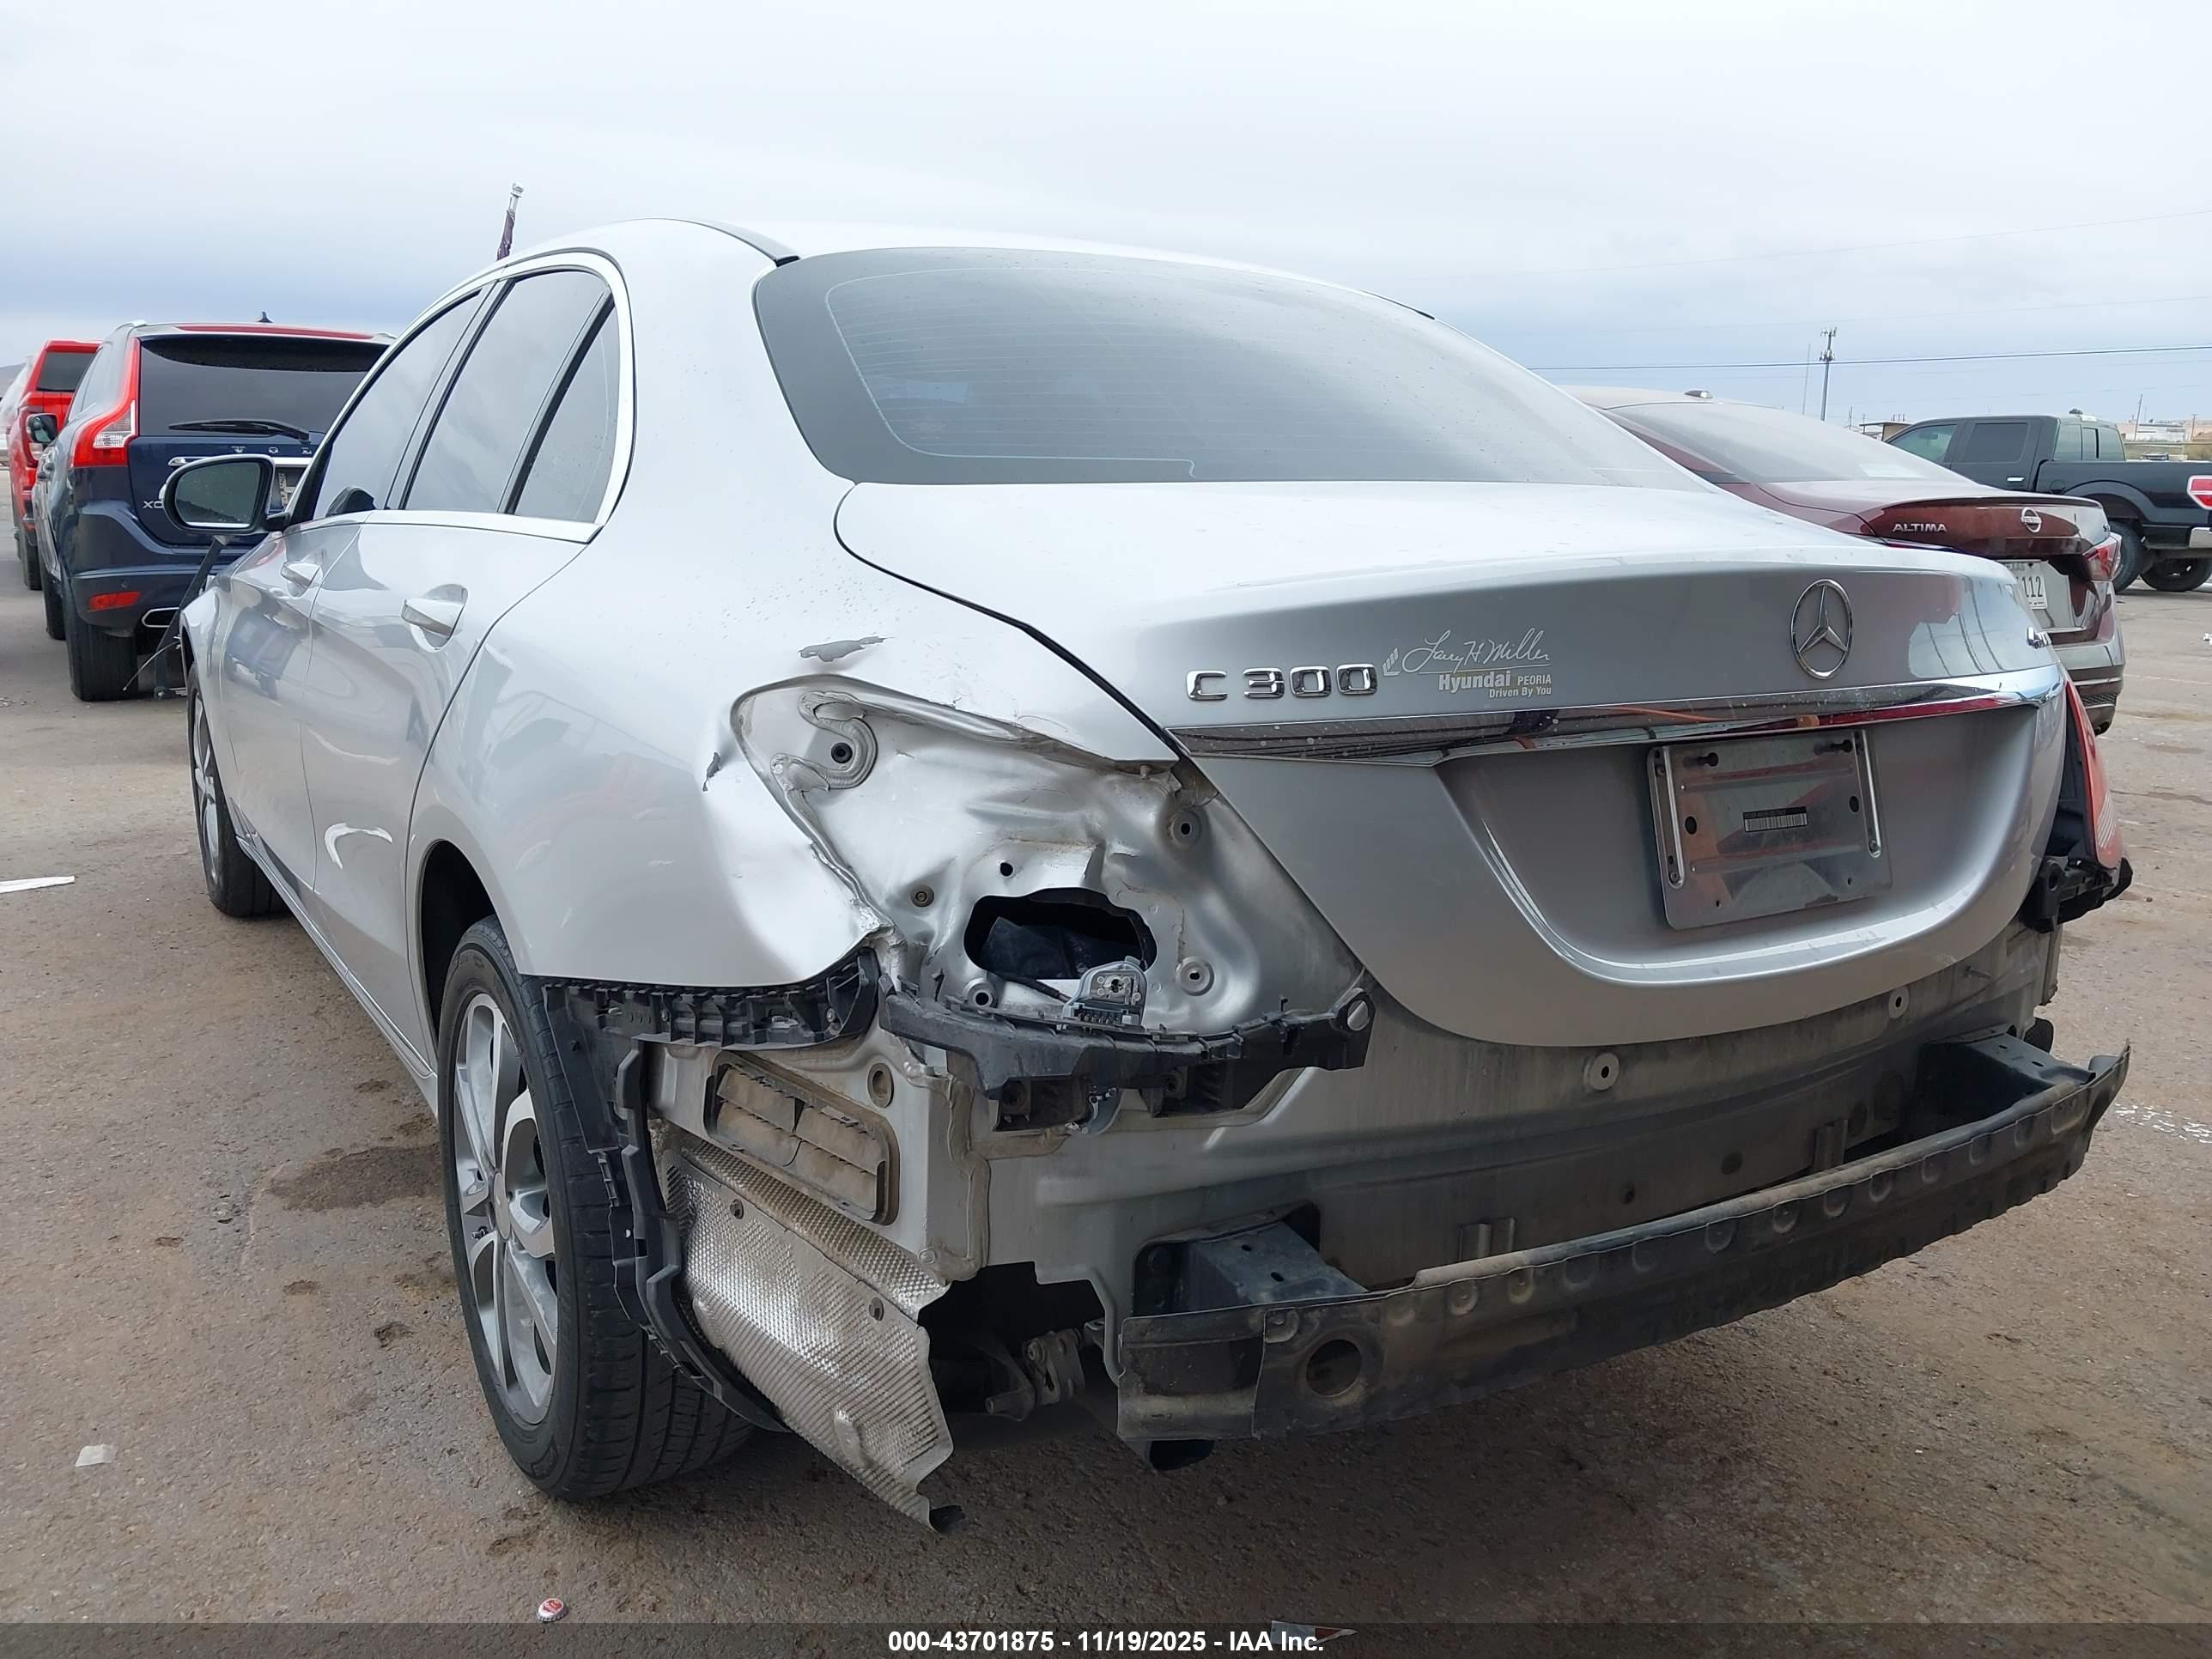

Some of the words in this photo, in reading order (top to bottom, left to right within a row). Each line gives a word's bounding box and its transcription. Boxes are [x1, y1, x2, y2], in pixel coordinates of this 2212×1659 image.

[143, 501, 163, 509] XC
[1892, 522, 1948, 533] ALTIMA
[2016, 575, 2043, 598] 112
[1401, 629, 1463, 673] Larry
[1483, 627, 1550, 665] Miller
[1186, 670, 1228, 702] C
[1243, 663, 1378, 699] 300
[1438, 670, 1511, 694] Hyundai
[1517, 673, 1552, 685] PEORIA
[1489, 687, 1519, 699] Driven
[1522, 686, 1534, 698] By
[1536, 685, 1552, 696] You
